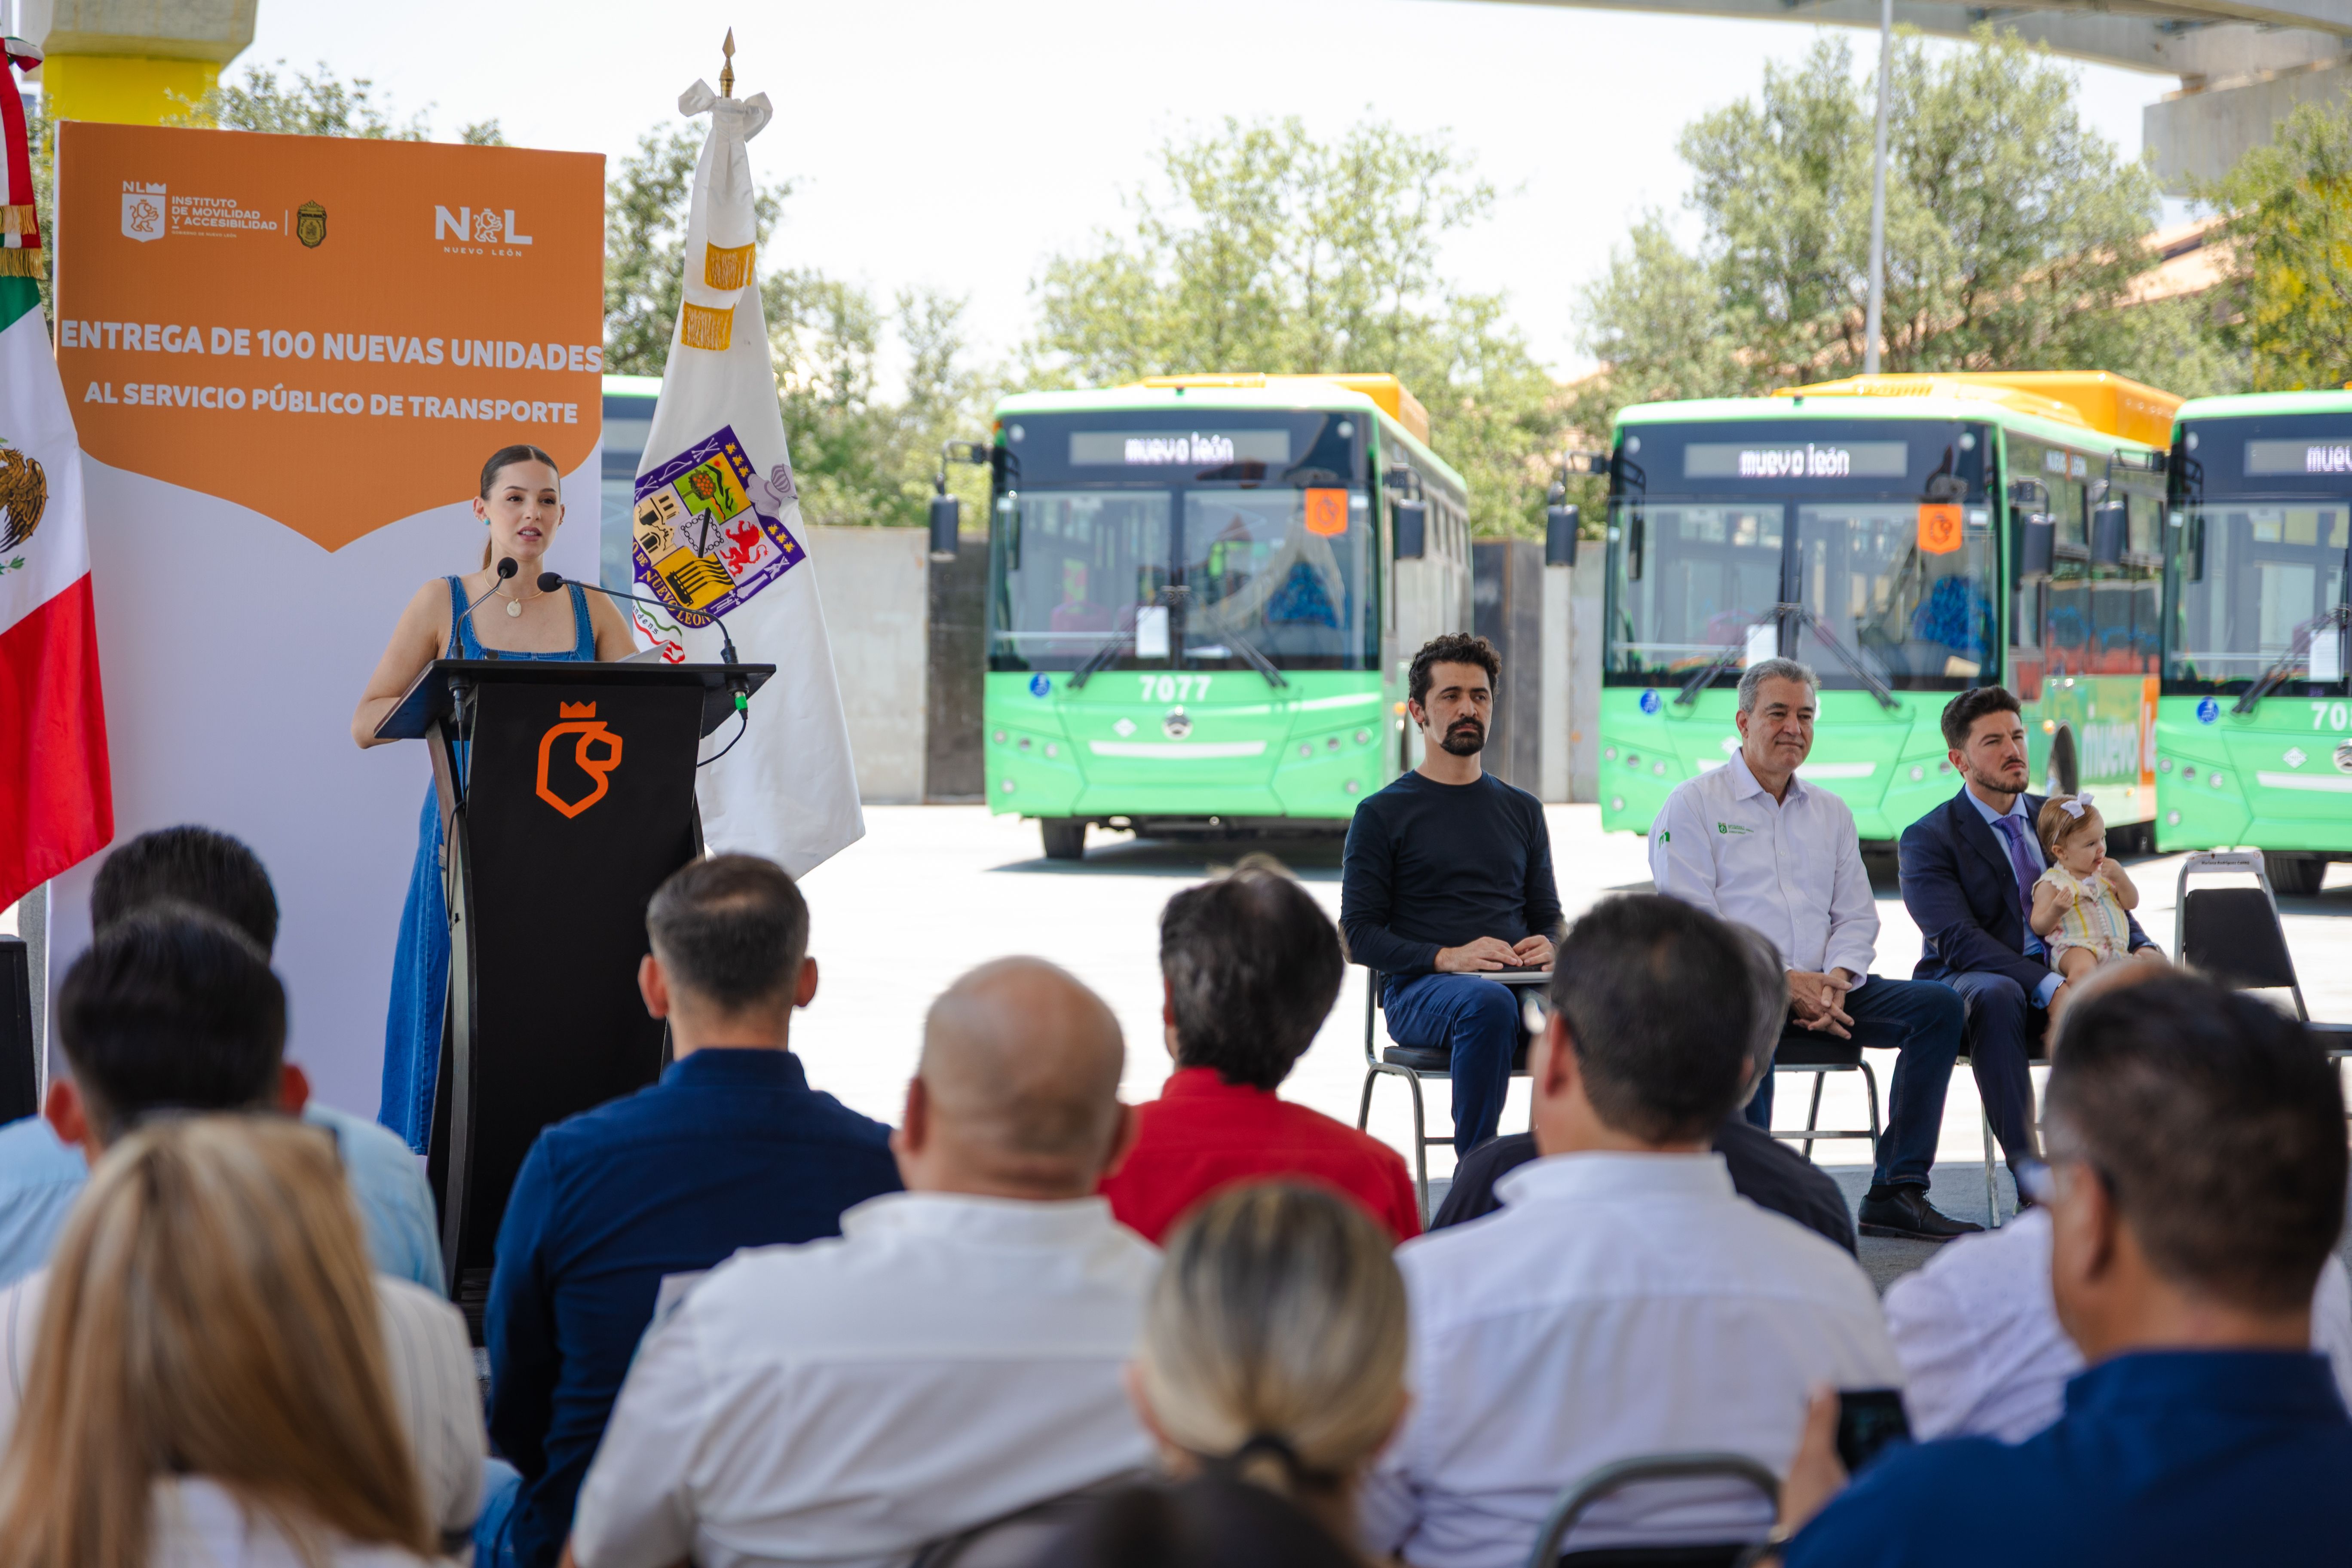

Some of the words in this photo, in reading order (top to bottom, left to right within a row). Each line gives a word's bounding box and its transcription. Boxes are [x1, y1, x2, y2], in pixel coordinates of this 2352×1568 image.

[172, 196, 237, 208] INSTITUTO
[172, 206, 188, 215] DE
[192, 208, 260, 219] MOVILIDAD
[184, 217, 277, 230] ACCESIBILIDAD
[444, 247, 484, 255] NUEVO
[491, 248, 522, 257] LEÓN
[61, 320, 204, 353] ENTREGA
[211, 327, 250, 355] DE
[257, 330, 315, 359] 100
[323, 333, 444, 365] NUEVAS
[451, 339, 603, 373] UNIDADES
[84, 382, 118, 404] AL
[123, 383, 246, 409] SERVICIO
[252, 383, 364, 415] PÚBLICO
[370, 394, 403, 416] DE
[408, 396, 578, 424] TRANSPORTE
[1807, 443, 1850, 477] león
[636, 552, 648, 567] DE
[638, 570, 678, 611] NUEVO
[1139, 674, 1212, 703] 7077
[2311, 701, 2352, 731] 70
